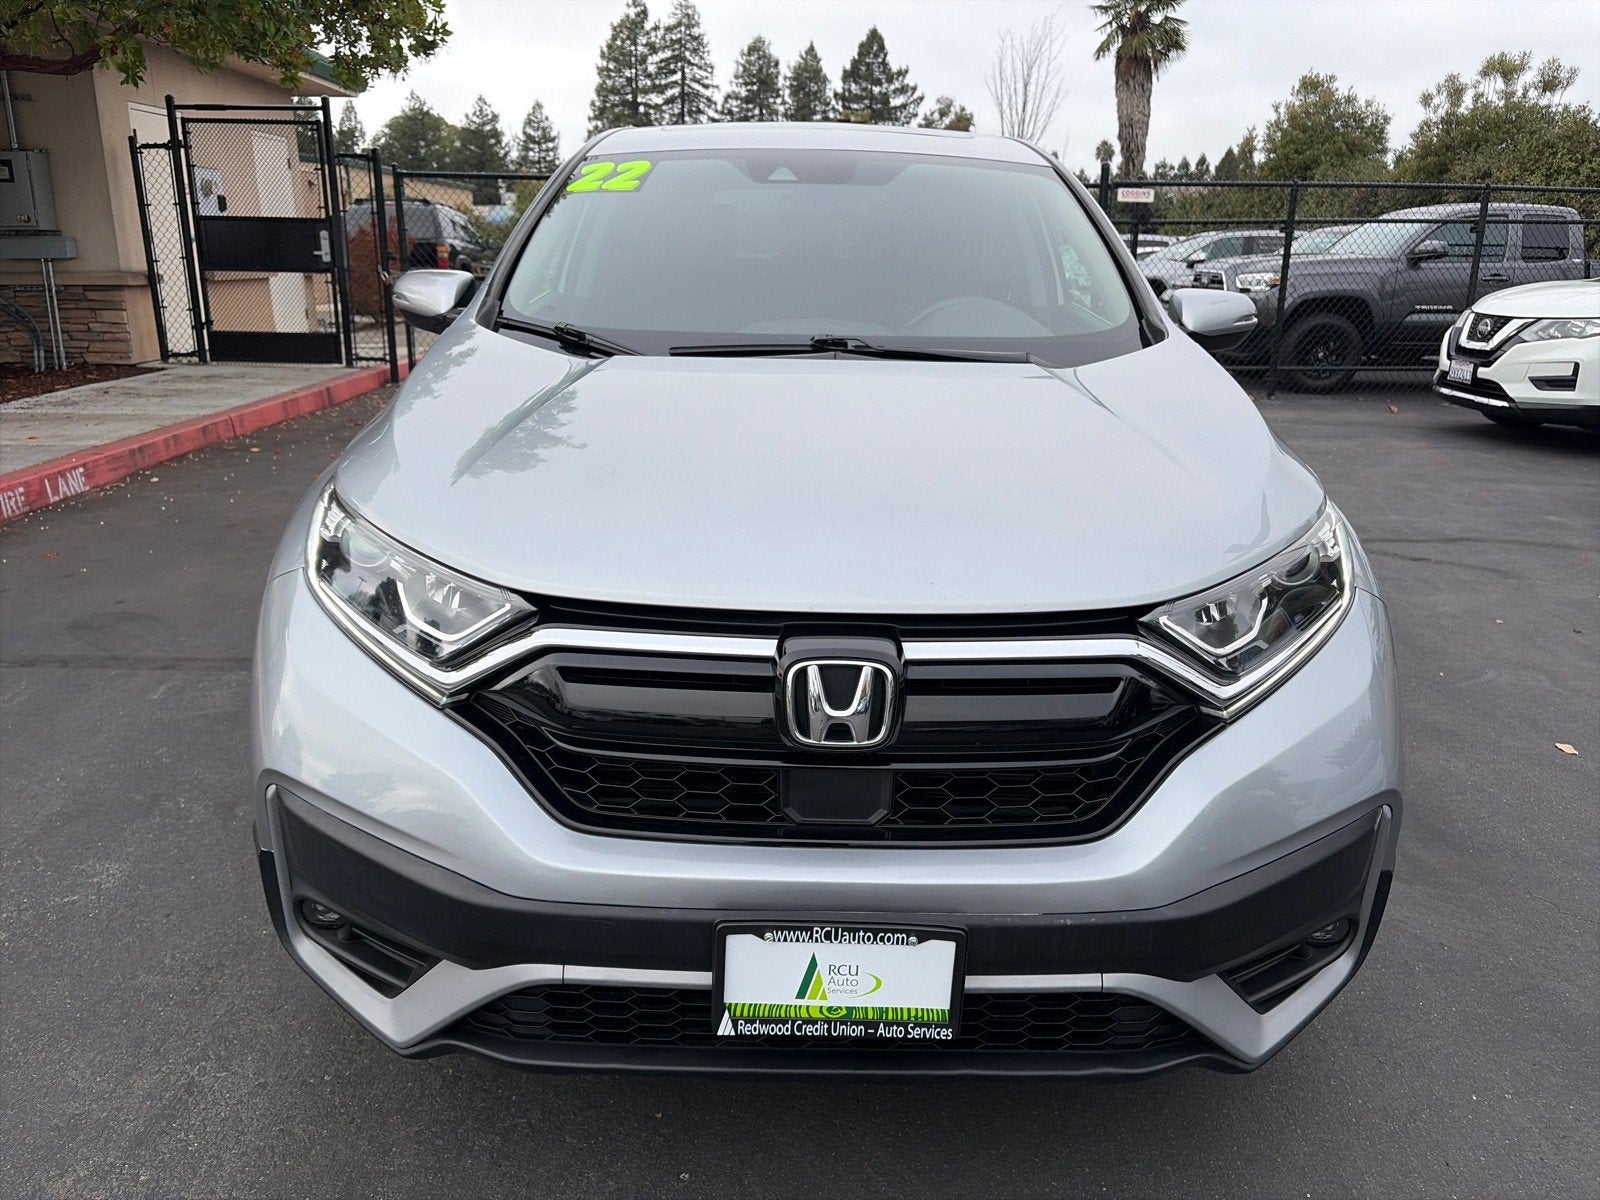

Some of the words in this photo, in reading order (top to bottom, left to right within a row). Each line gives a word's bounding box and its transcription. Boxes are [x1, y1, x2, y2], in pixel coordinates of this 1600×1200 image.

[566, 160, 652, 193] 22
[0, 486, 30, 519] IRE
[44, 466, 90, 503] LANE
[773, 927, 907, 946] www.RCUauto.com
[828, 964, 860, 977] RCU
[827, 976, 859, 988] Auto
[827, 987, 859, 995] Services
[737, 1020, 791, 1036] Redwood
[793, 1020, 828, 1036] Credit
[831, 1021, 865, 1037] Union
[876, 1022, 905, 1038] Auto
[906, 1023, 953, 1040] Services
